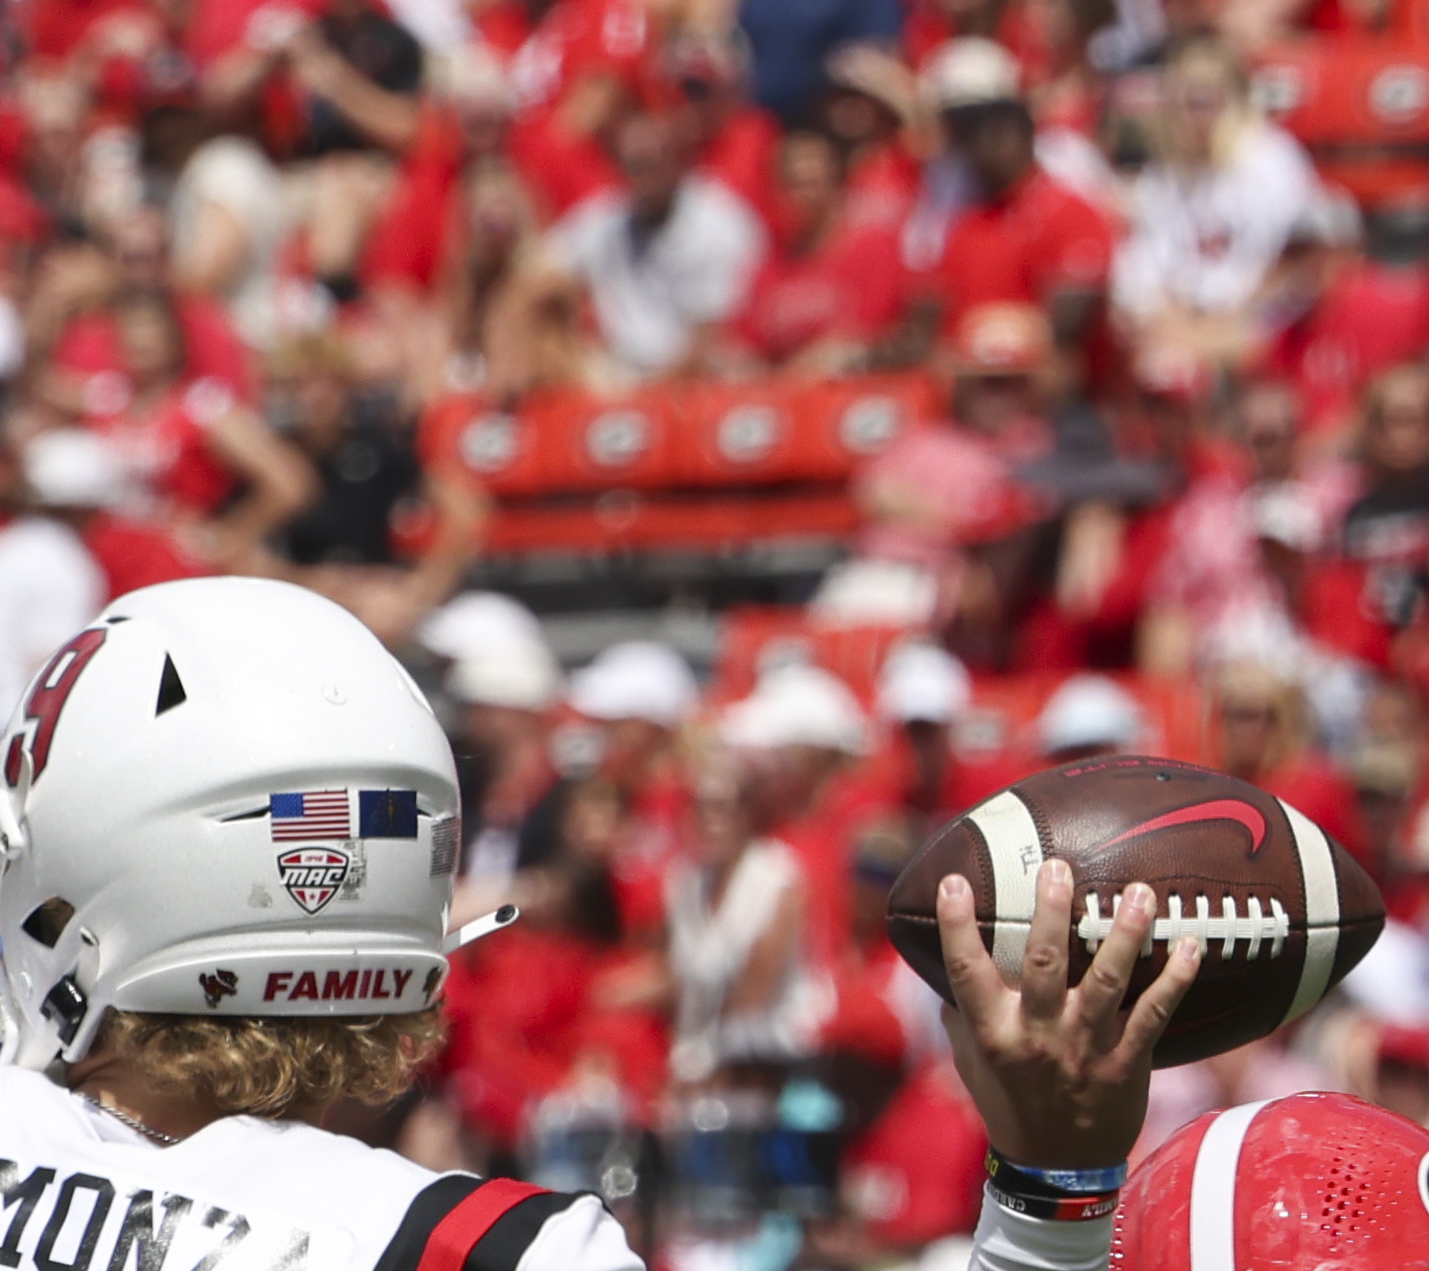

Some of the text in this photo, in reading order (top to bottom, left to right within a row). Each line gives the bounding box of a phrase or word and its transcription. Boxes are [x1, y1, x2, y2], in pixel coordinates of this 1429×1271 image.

[4, 628, 107, 788] 9
[281, 866, 346, 886] MAC
[263, 967, 413, 1002] FAMILY
